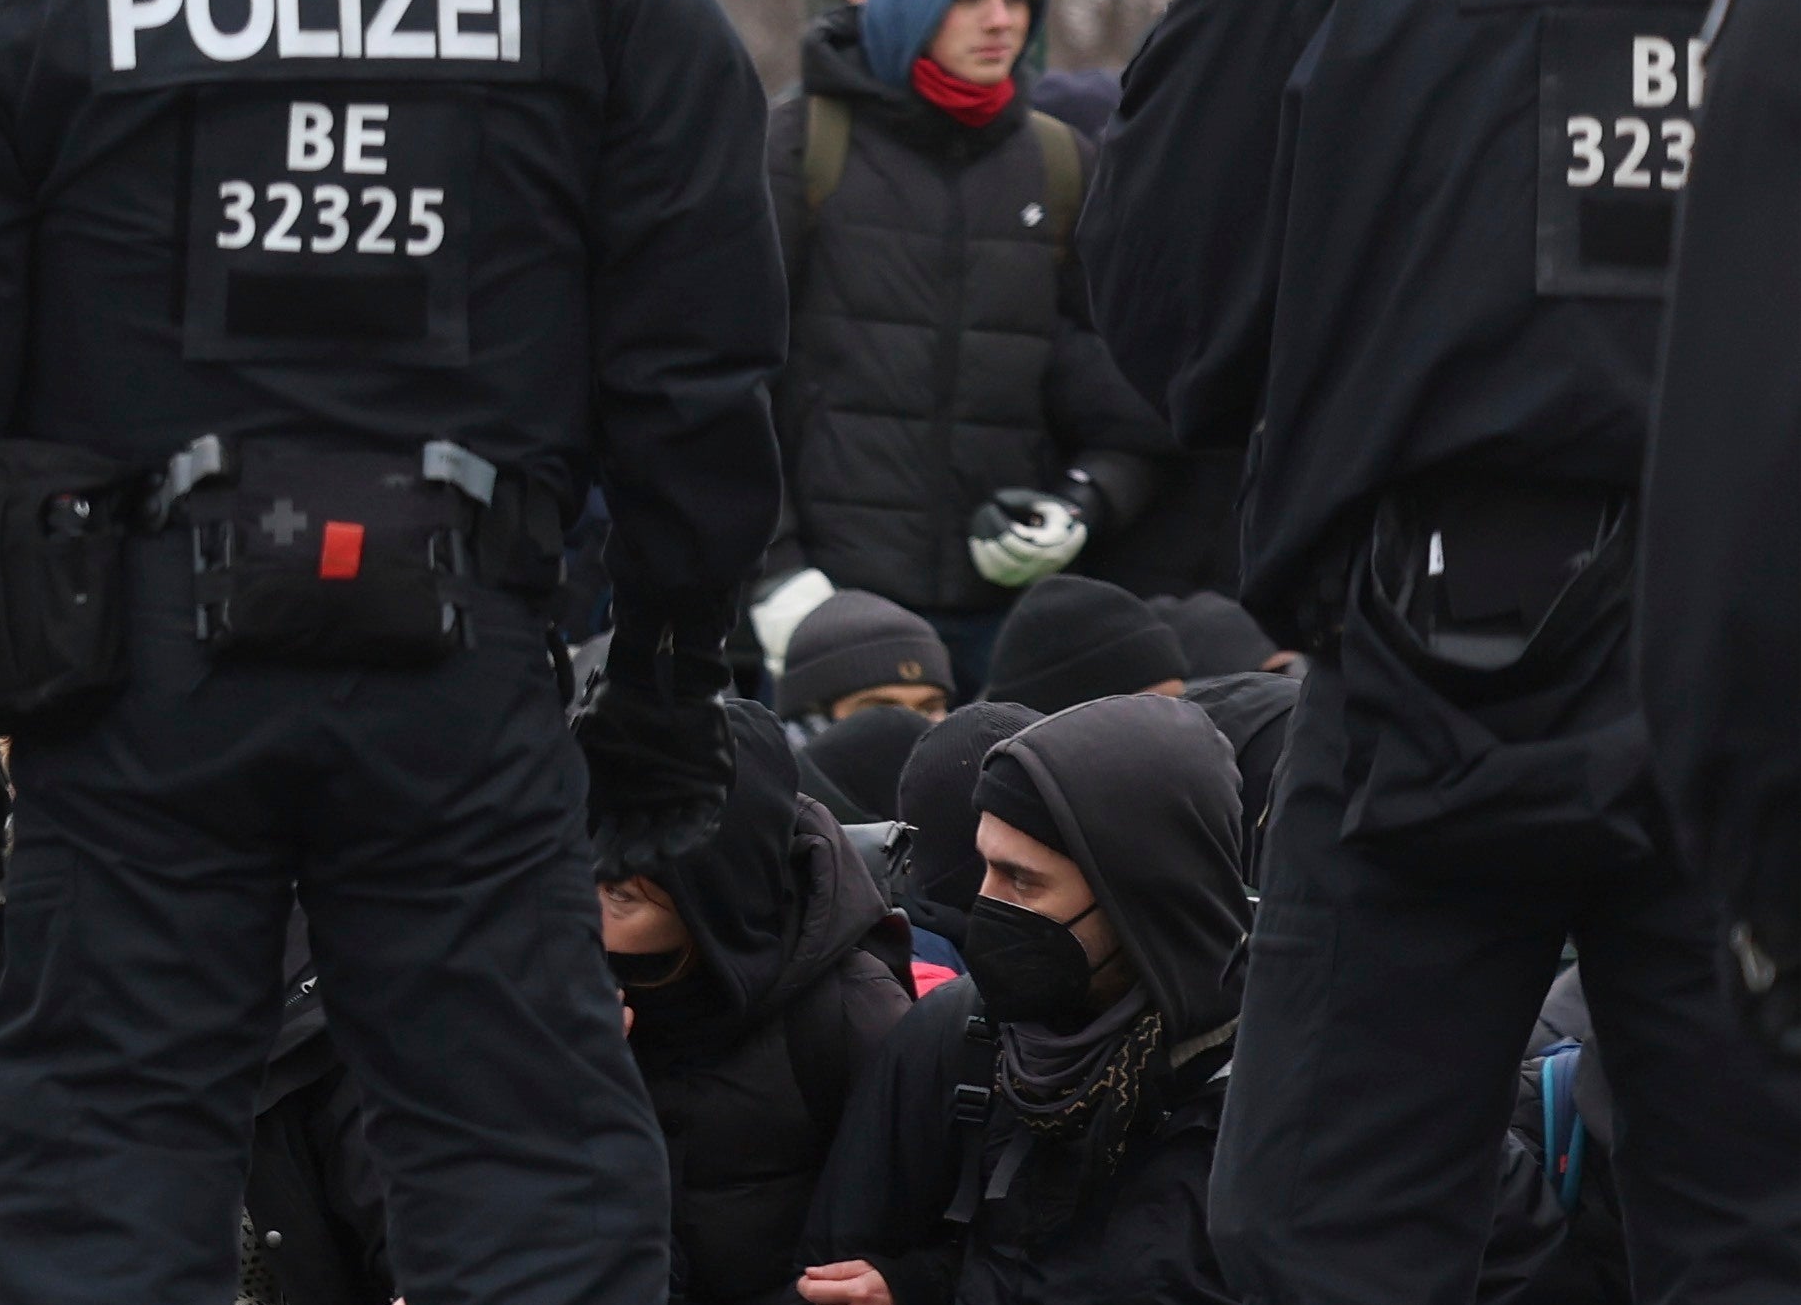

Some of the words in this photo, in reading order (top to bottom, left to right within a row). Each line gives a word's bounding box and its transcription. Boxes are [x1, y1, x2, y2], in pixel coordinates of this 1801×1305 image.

[287, 101, 389, 175] BE
[1566, 116, 1696, 189] 323
[216, 180, 445, 256] 32325
